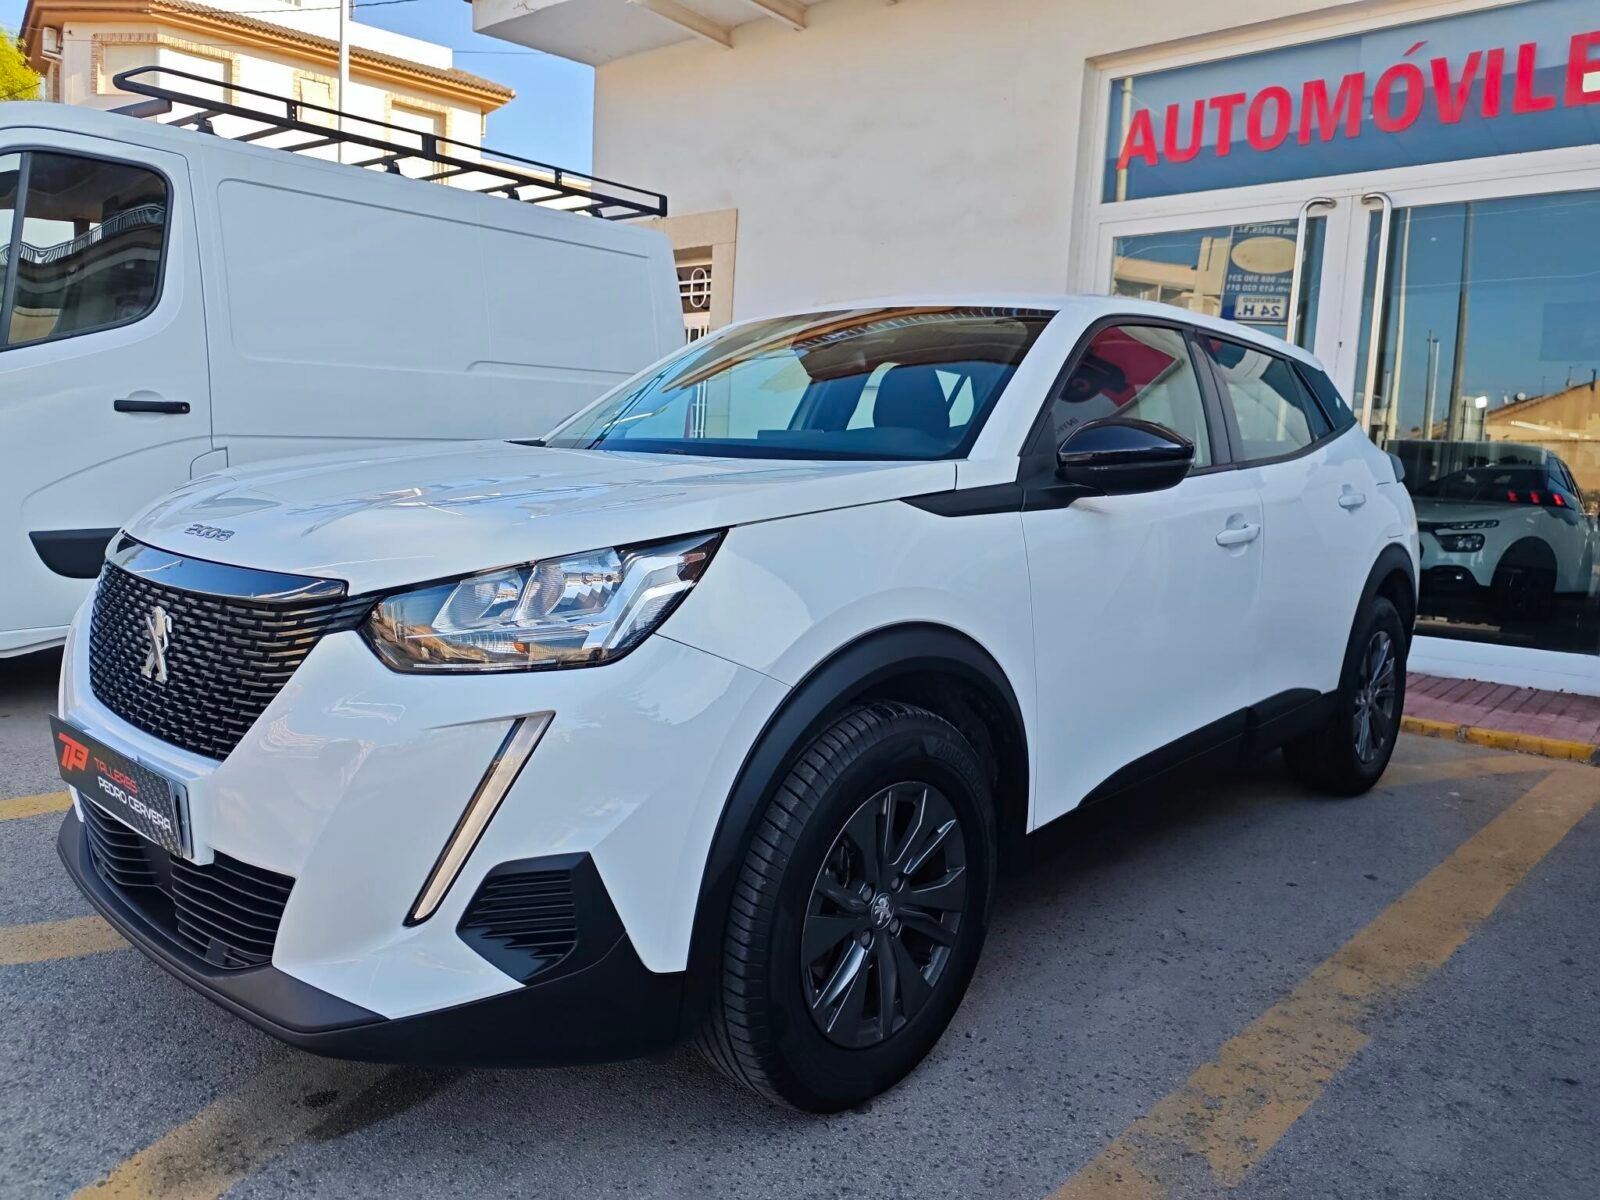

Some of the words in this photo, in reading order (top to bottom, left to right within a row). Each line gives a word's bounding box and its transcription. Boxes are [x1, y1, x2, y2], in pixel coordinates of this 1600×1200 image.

[1116, 30, 1600, 170] AUTOMÓVILE
[184, 523, 235, 541] 2008
[94, 757, 138, 794] TALLERES
[97, 776, 127, 804] PEDRO
[128, 796, 172, 832] CERVERA
